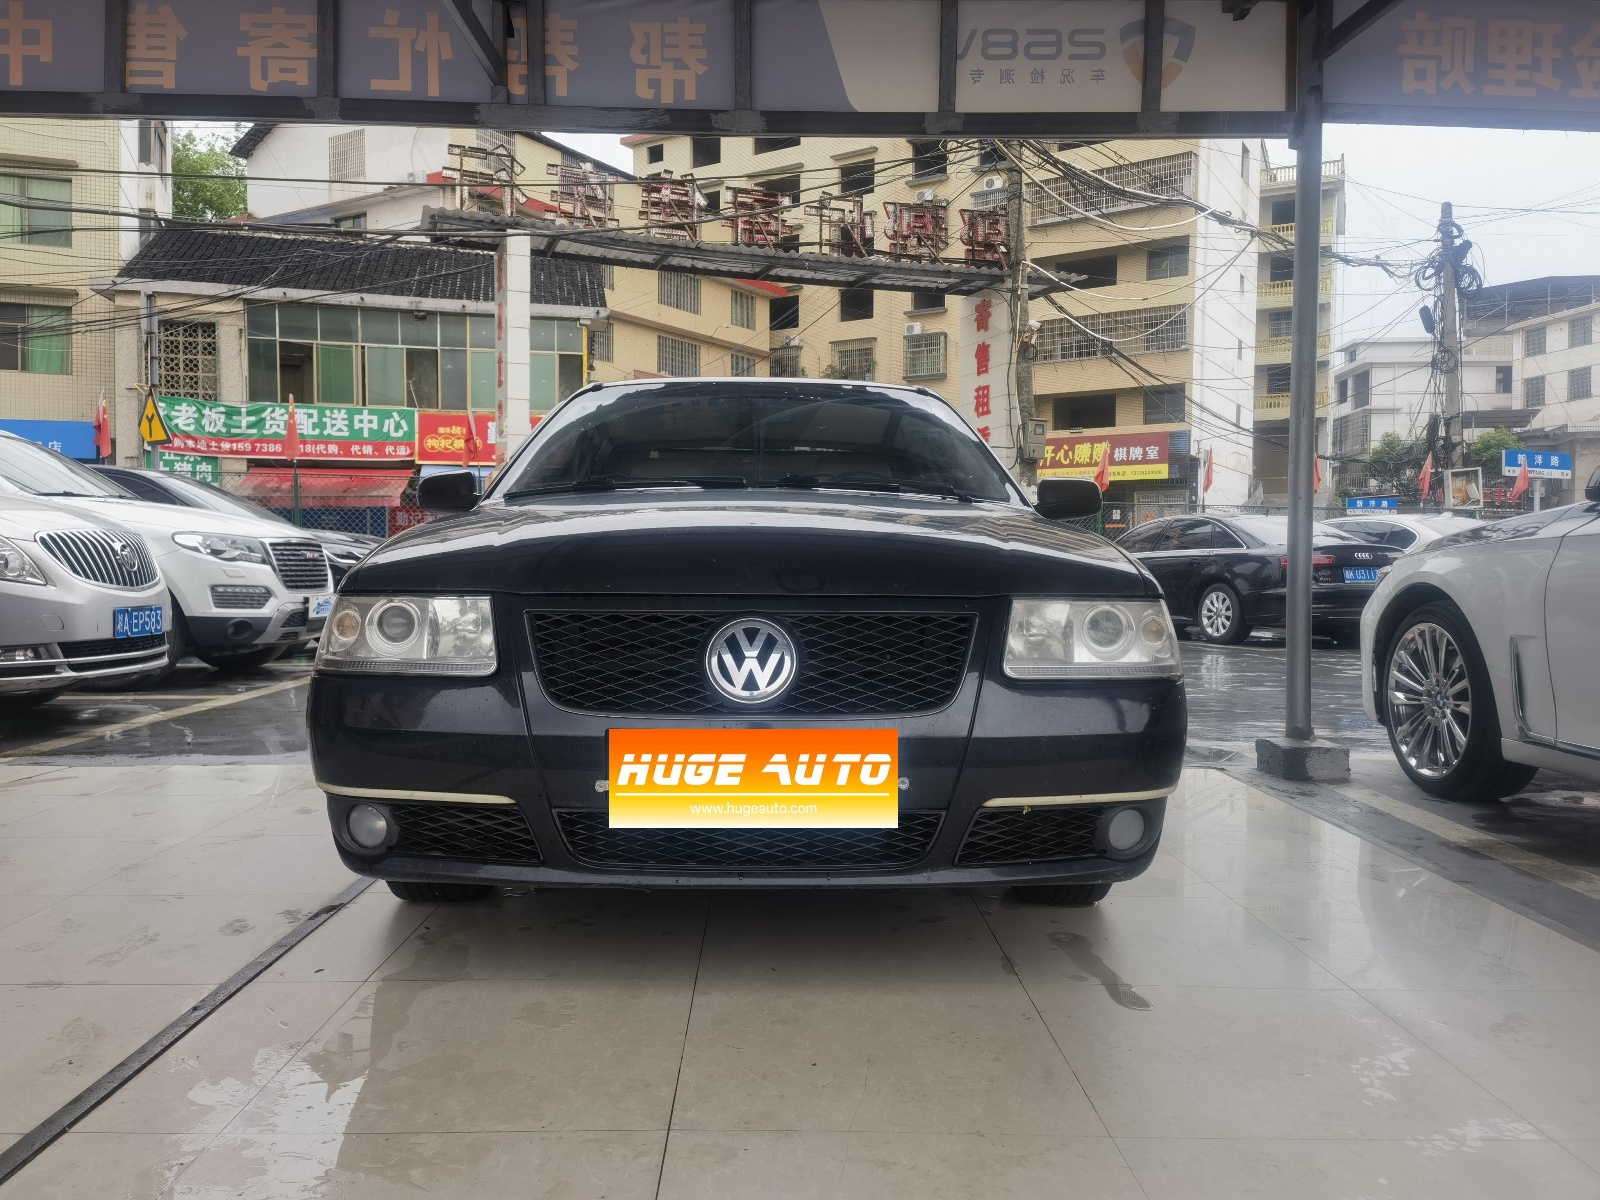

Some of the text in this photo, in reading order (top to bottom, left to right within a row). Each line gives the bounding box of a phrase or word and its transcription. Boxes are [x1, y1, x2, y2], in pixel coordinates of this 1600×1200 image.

[158, 402, 409, 438] 老板土货配送中心
[1114, 446, 1159, 462] 棋牌室
[1517, 453, 1560, 467] 新洋路
[1356, 500, 1388, 508] 新洋路
